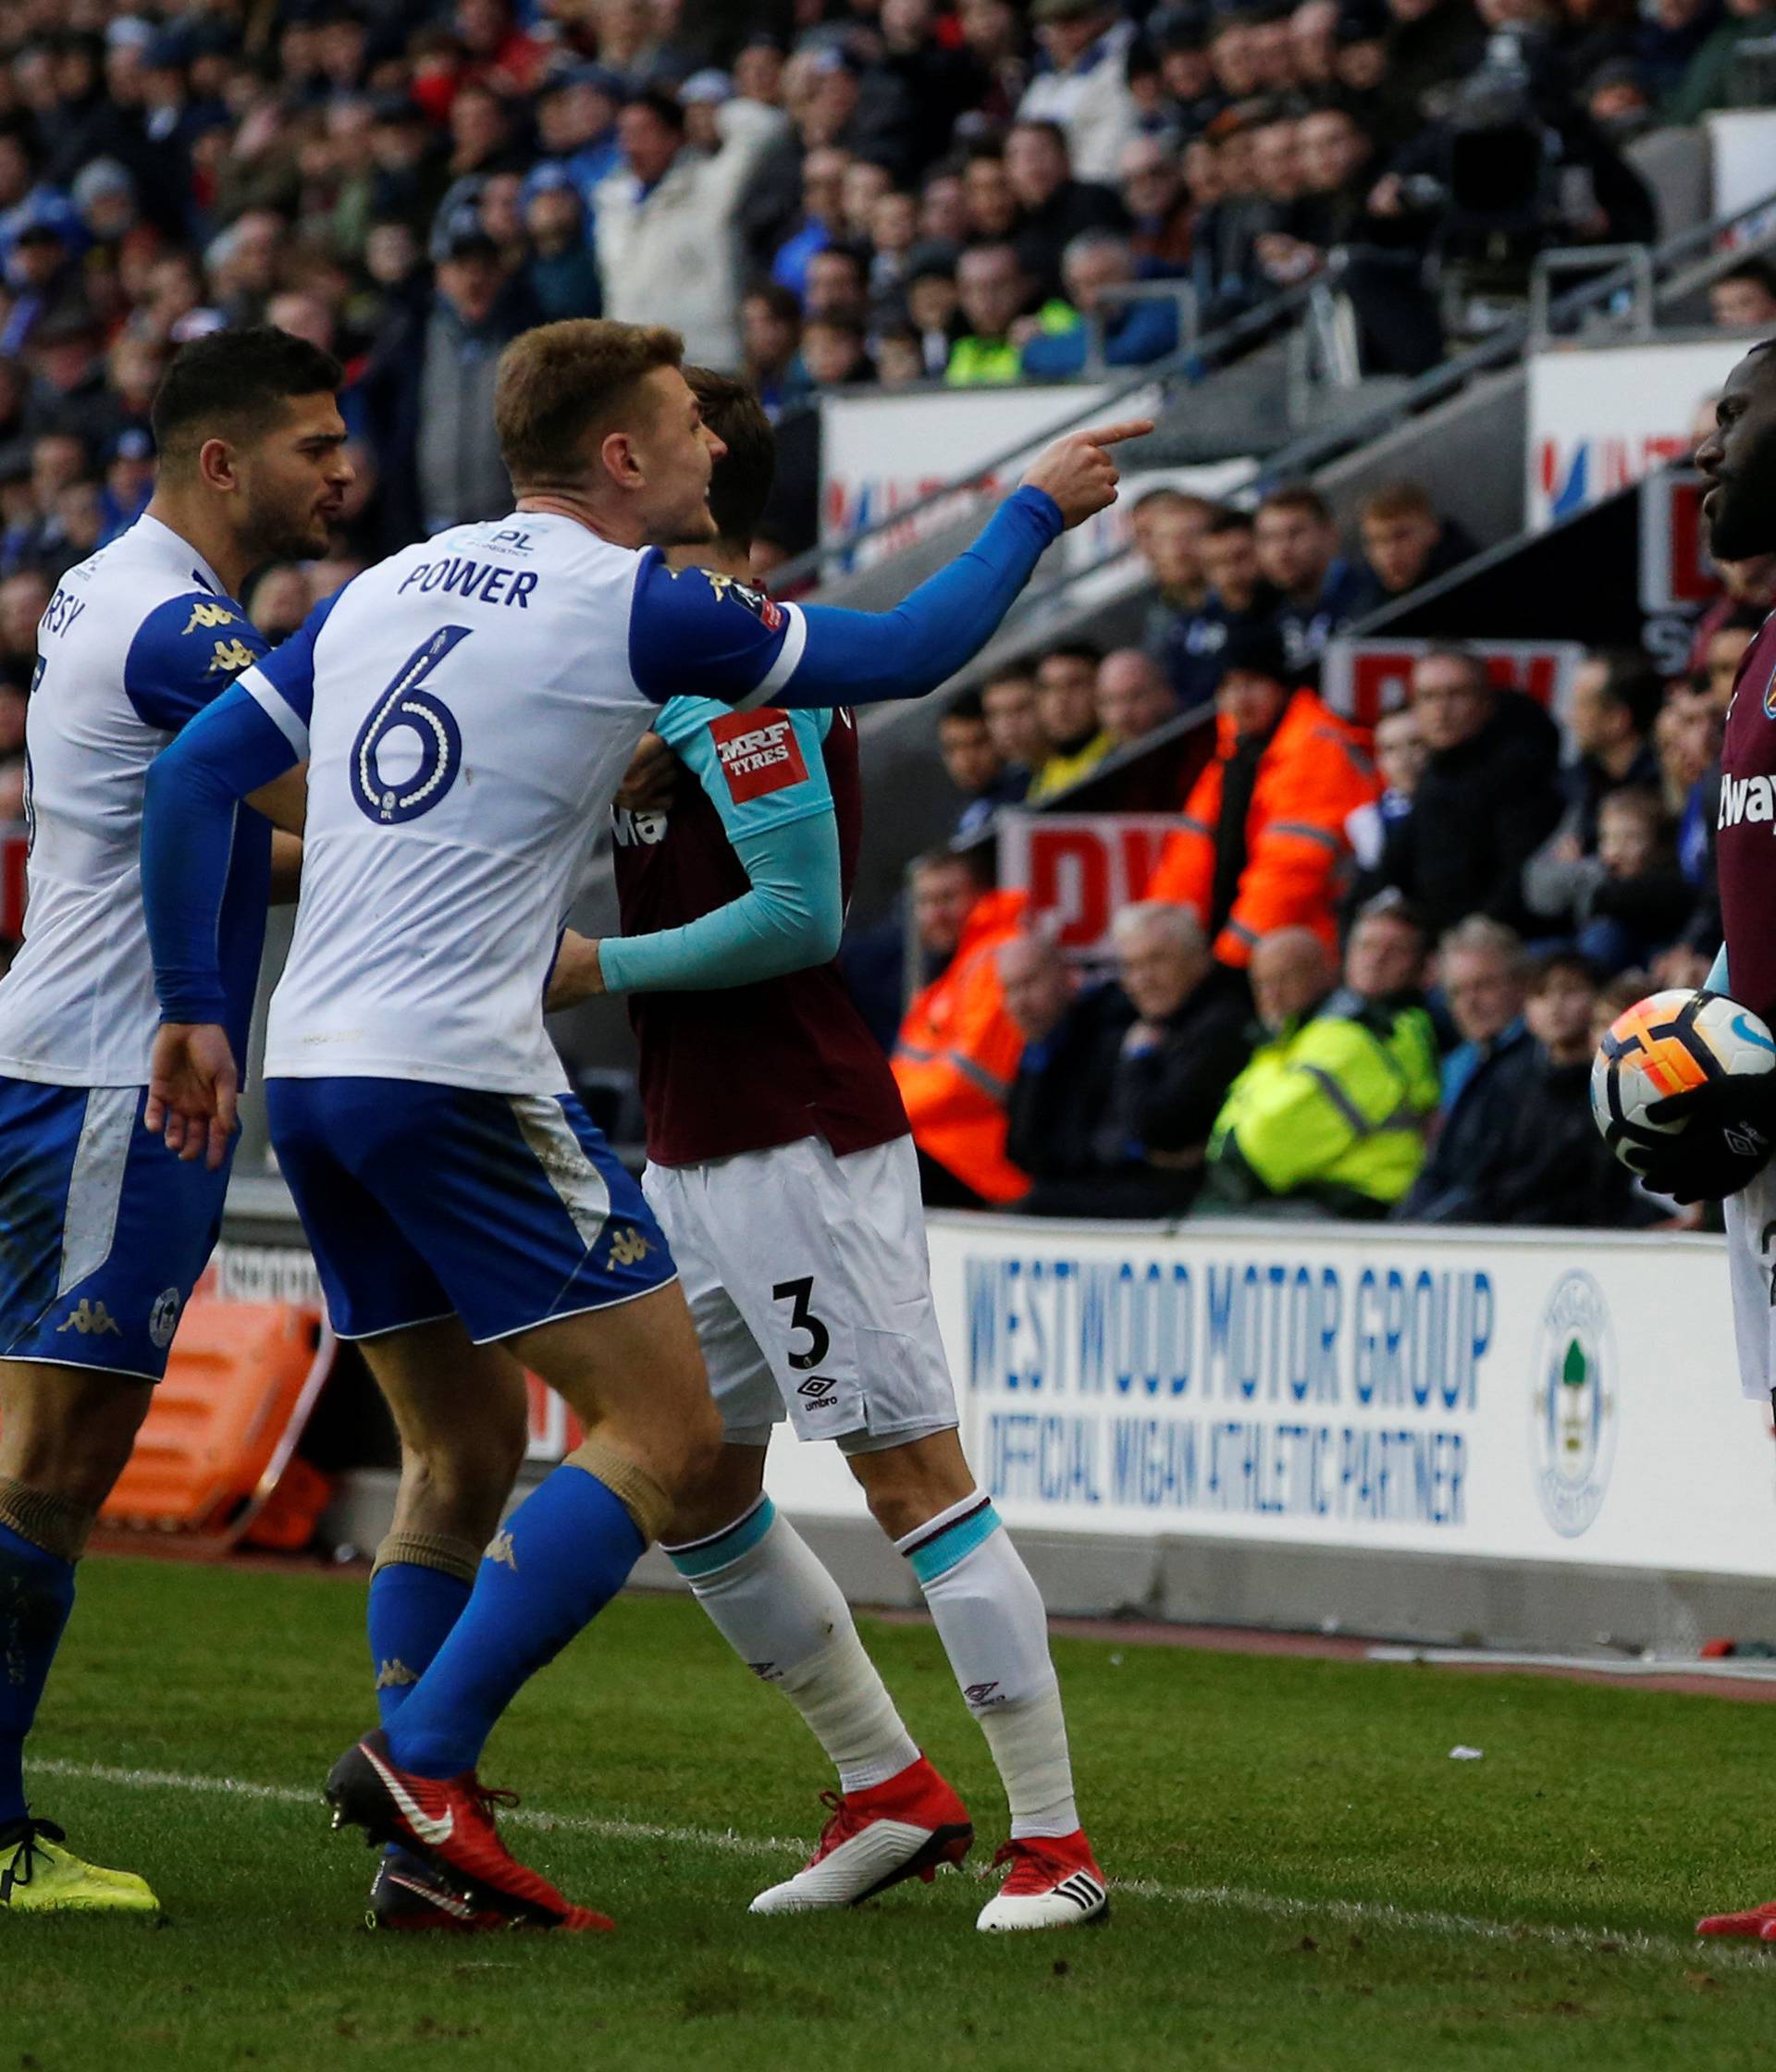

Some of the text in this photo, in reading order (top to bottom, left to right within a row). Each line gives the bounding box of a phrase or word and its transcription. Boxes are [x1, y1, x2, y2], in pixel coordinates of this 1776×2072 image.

[397, 557, 538, 609] POWER
[350, 624, 474, 825] 6
[718, 721, 790, 762] MRF
[729, 744, 789, 777] TYRES
[772, 1276, 829, 1370] 3
[965, 1259, 1192, 1395] WESTWOOD
[1203, 1264, 1339, 1406] MOTOR
[1354, 1267, 1495, 1412] GROUP
[805, 1395, 838, 1412] umbro
[986, 1413, 1101, 1504] OFFICIAL
[1110, 1418, 1200, 1509] WIGAN
[1207, 1421, 1327, 1517] ATHLETIC
[1339, 1426, 1466, 1524] PARTNER
